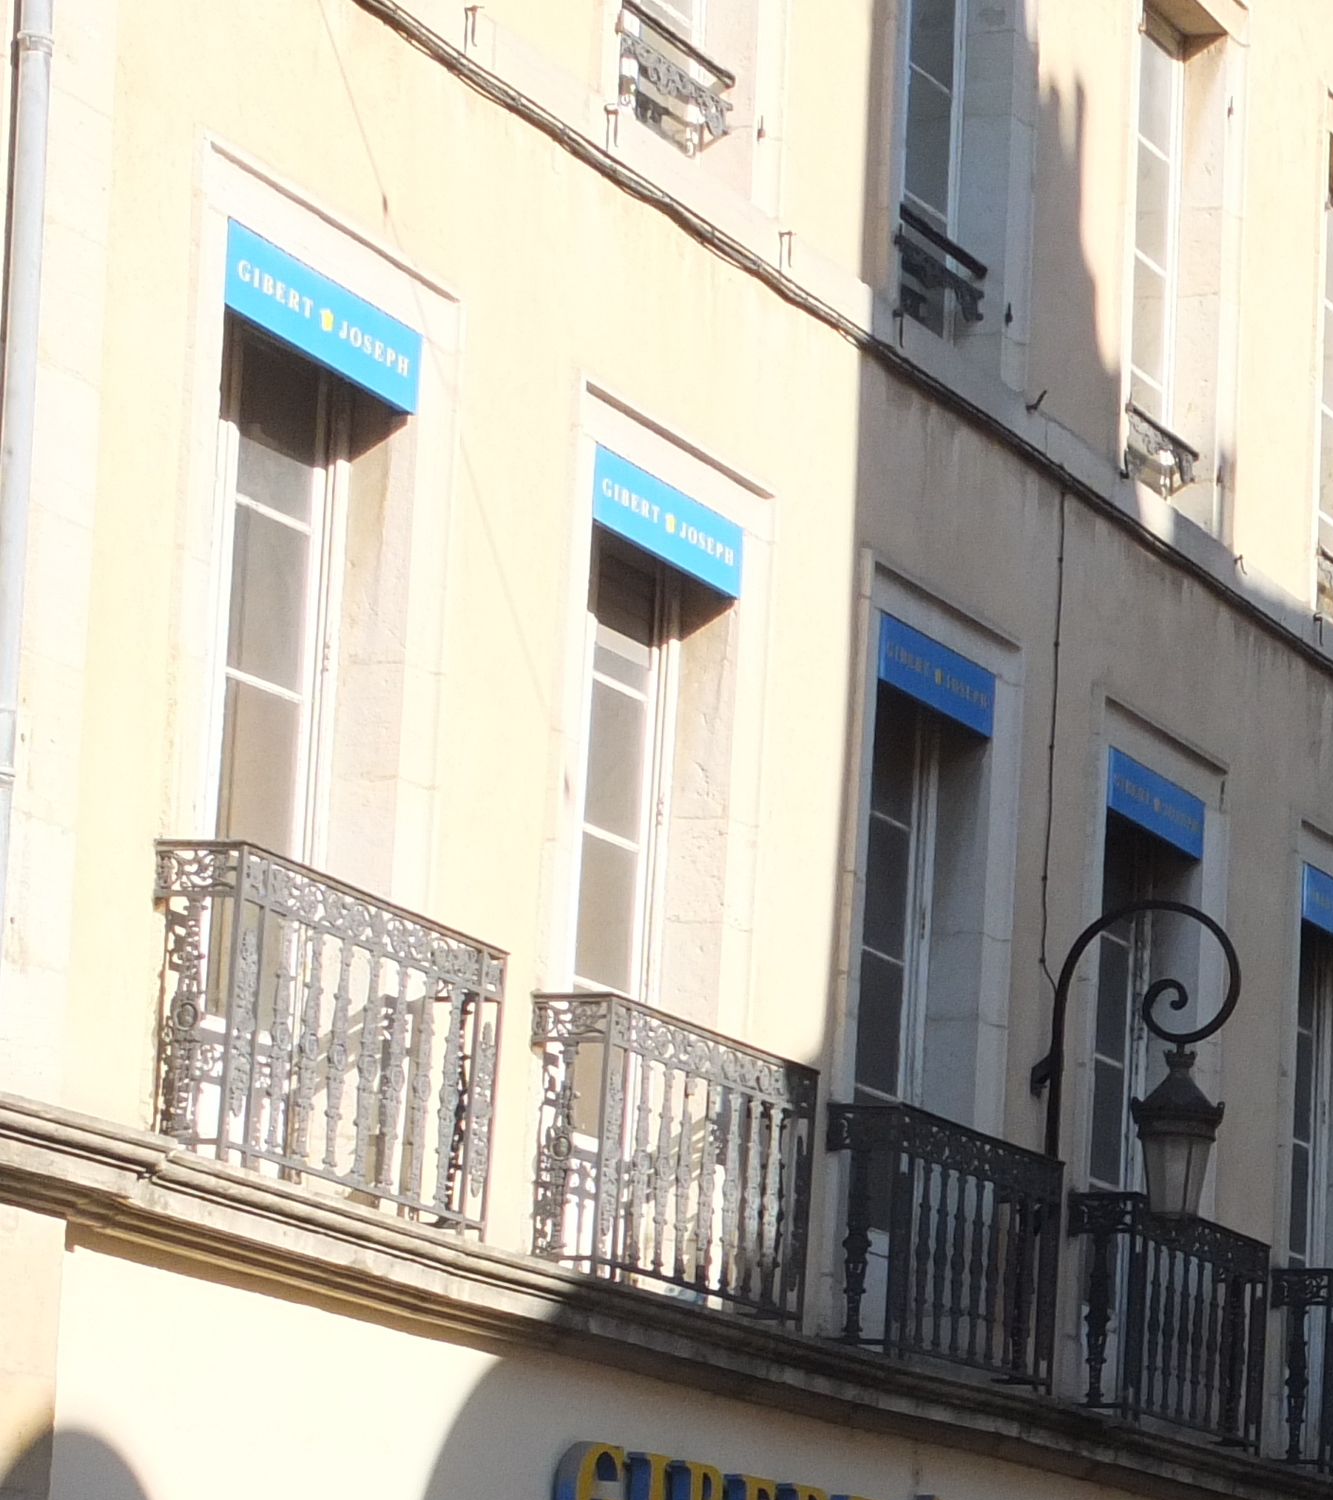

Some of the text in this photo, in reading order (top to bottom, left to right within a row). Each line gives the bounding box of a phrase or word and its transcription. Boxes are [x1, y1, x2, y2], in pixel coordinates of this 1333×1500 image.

[237, 259, 411, 378] GIBERT JOSEPH
[602, 477, 735, 567] GIBERT JOSEPH
